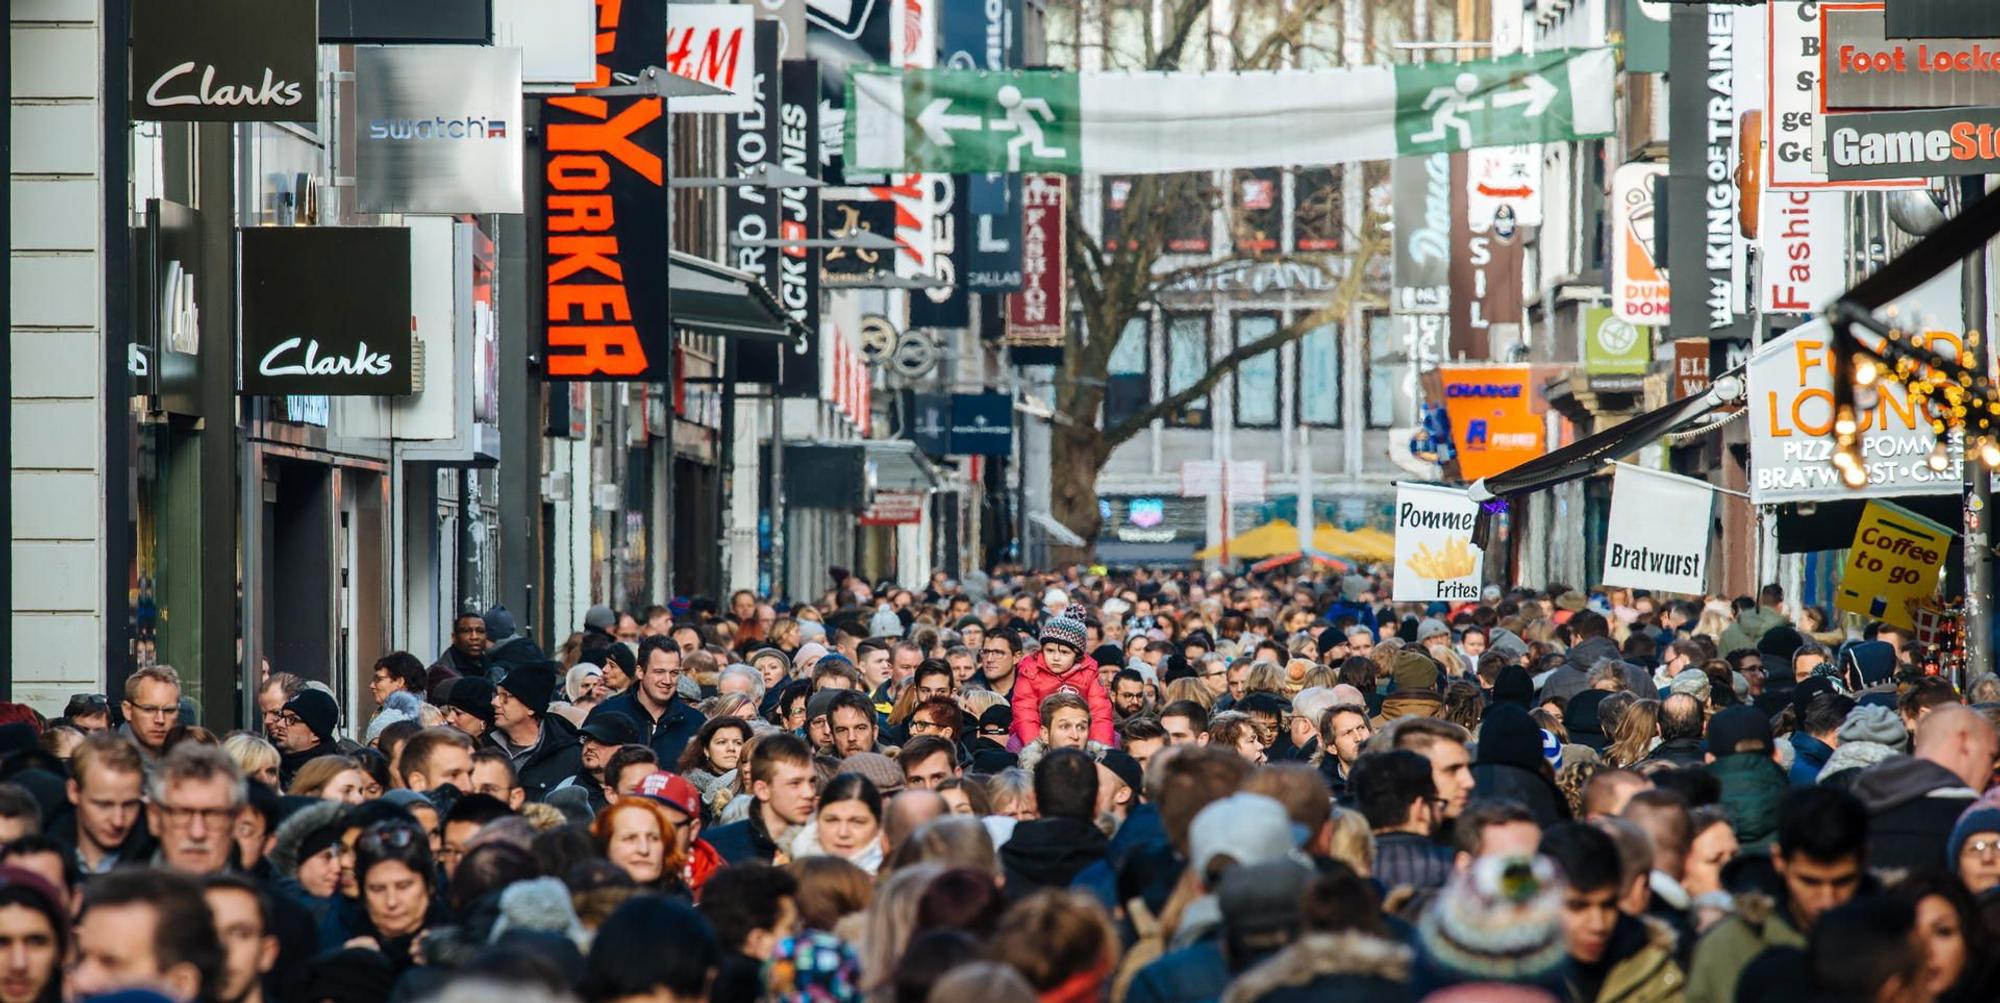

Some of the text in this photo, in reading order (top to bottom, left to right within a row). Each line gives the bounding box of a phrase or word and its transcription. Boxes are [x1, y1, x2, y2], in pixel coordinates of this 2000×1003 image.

[1839, 44, 1906, 73] Foot
[147, 61, 302, 107] Clarks
[369, 116, 486, 140] swatch
[1708, 145, 1729, 181] OF
[1707, 183, 1732, 270] KING
[1024, 208, 1048, 322] FASHION
[259, 337, 392, 377] Clarks
[1445, 383, 1522, 398] CHANGE
[1783, 438, 1840, 462] PIZZ
[1400, 502, 1476, 531] Pomme
[1610, 542, 1700, 577] Bratwurst
[1861, 527, 1939, 566] Coffee
[1854, 551, 1921, 585] to go
[1436, 580, 1478, 599] Frites
